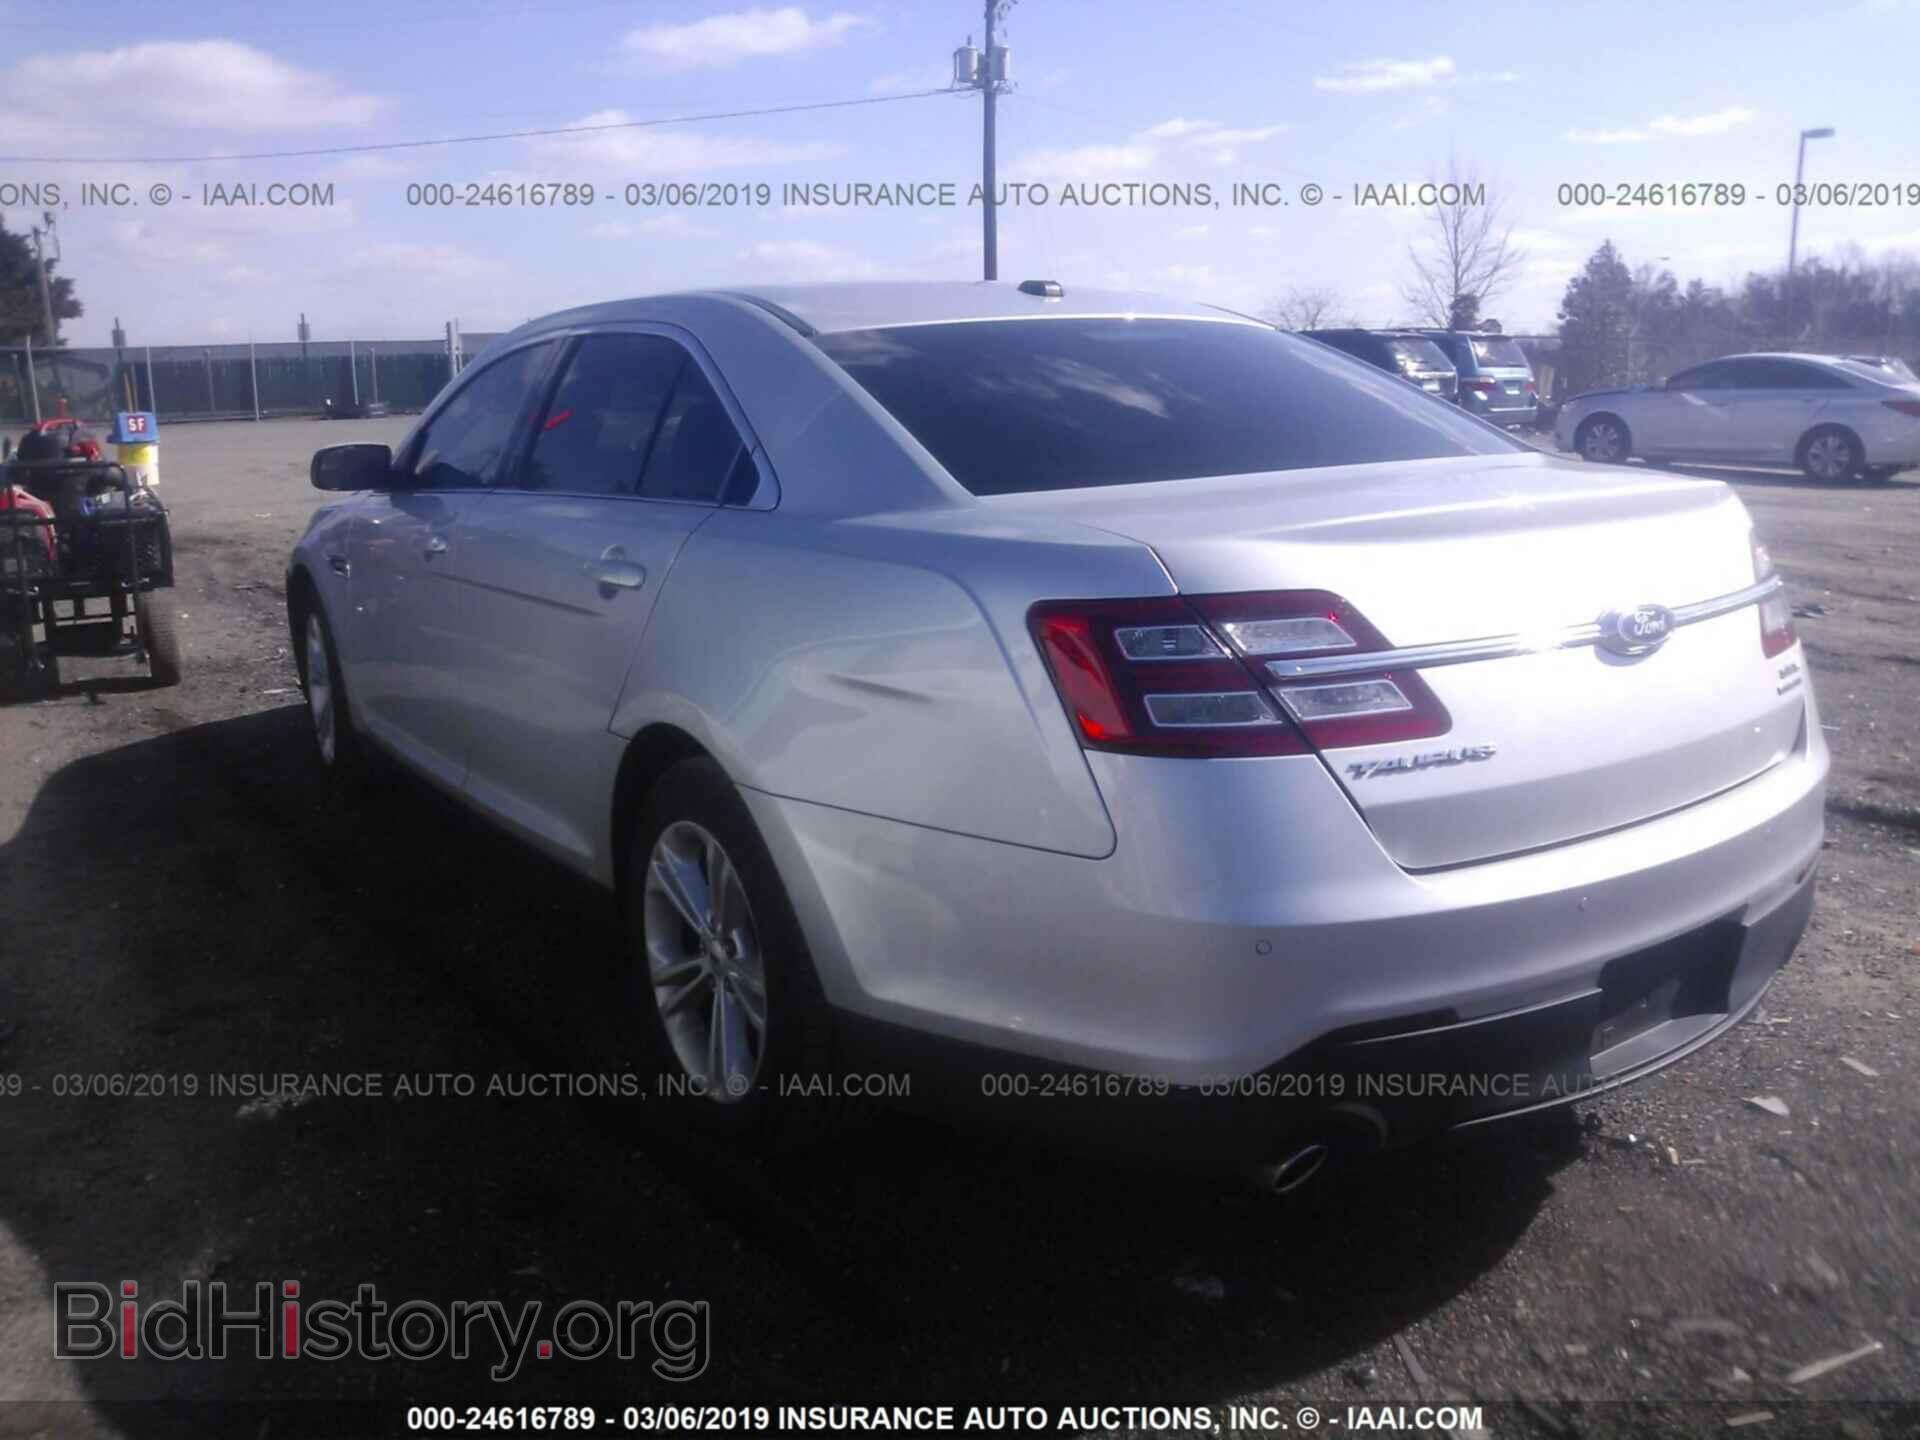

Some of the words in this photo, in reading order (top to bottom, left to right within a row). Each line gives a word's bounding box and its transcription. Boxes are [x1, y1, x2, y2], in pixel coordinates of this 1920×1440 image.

[128, 417, 145, 432] SF
[1634, 610, 1665, 636] Ford
[1345, 745, 1496, 781] TAURUS
